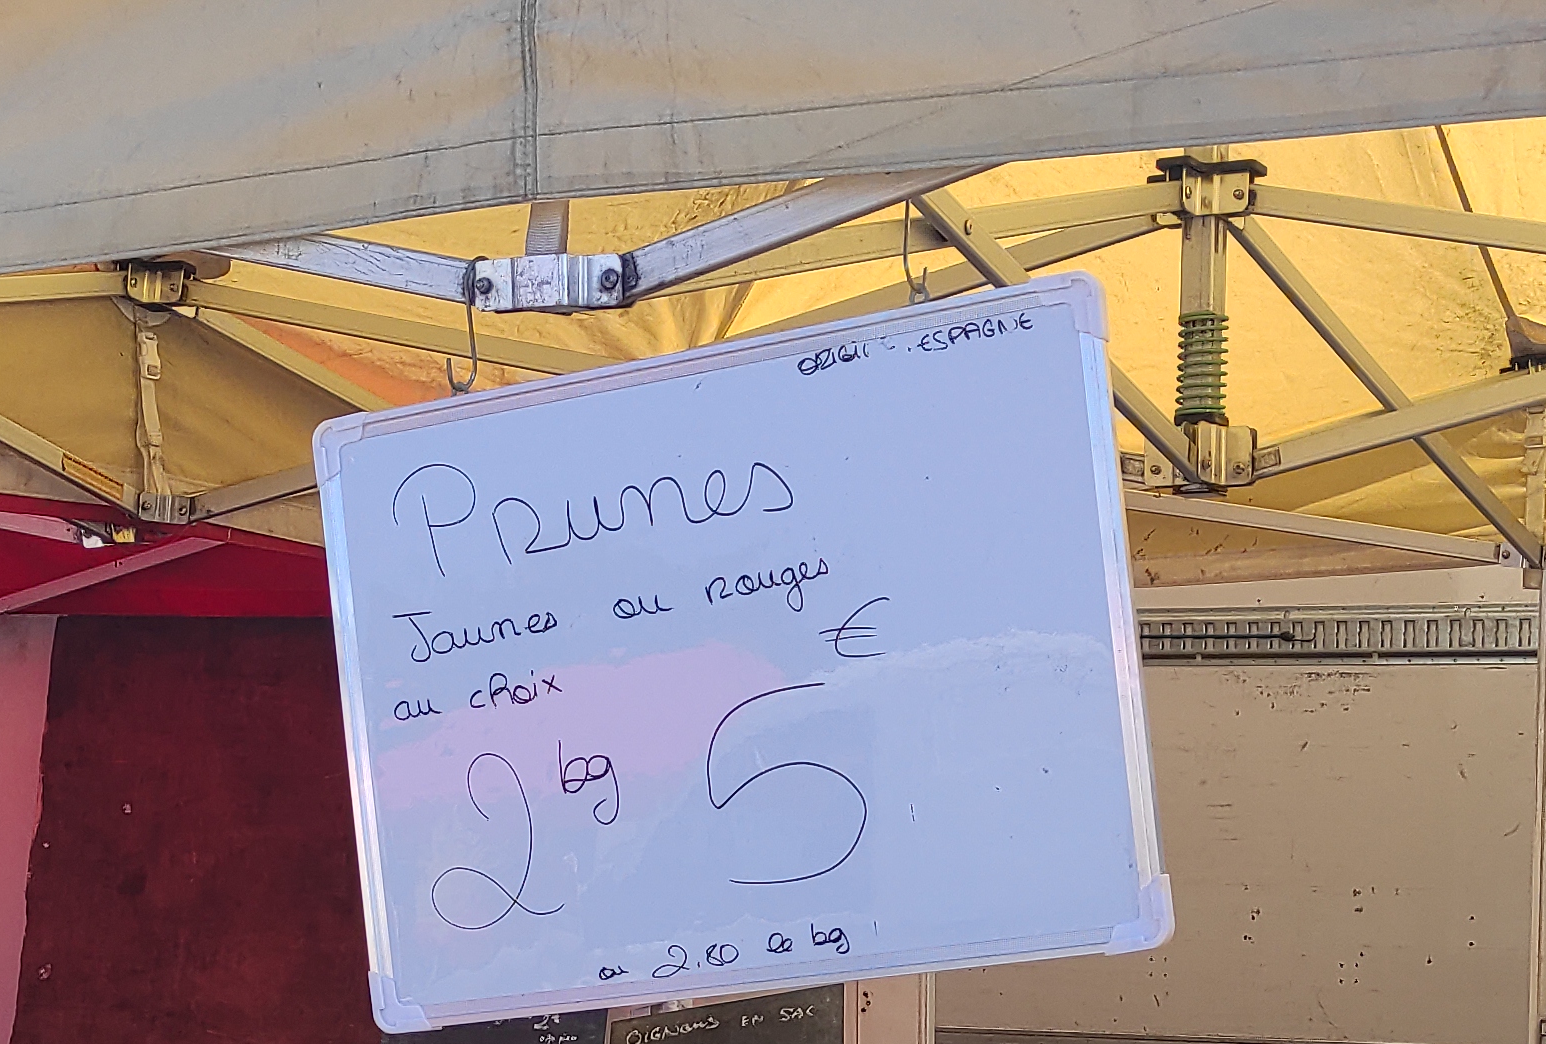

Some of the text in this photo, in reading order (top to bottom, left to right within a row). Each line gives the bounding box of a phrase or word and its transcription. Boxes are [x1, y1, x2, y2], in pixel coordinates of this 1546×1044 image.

[392, 610, 559, 664] Jaunes
[613, 593, 673, 620] ou
[393, 670, 564, 722] au choix
[431, 751, 565, 931] 2
[706, 682, 868, 885] 5
